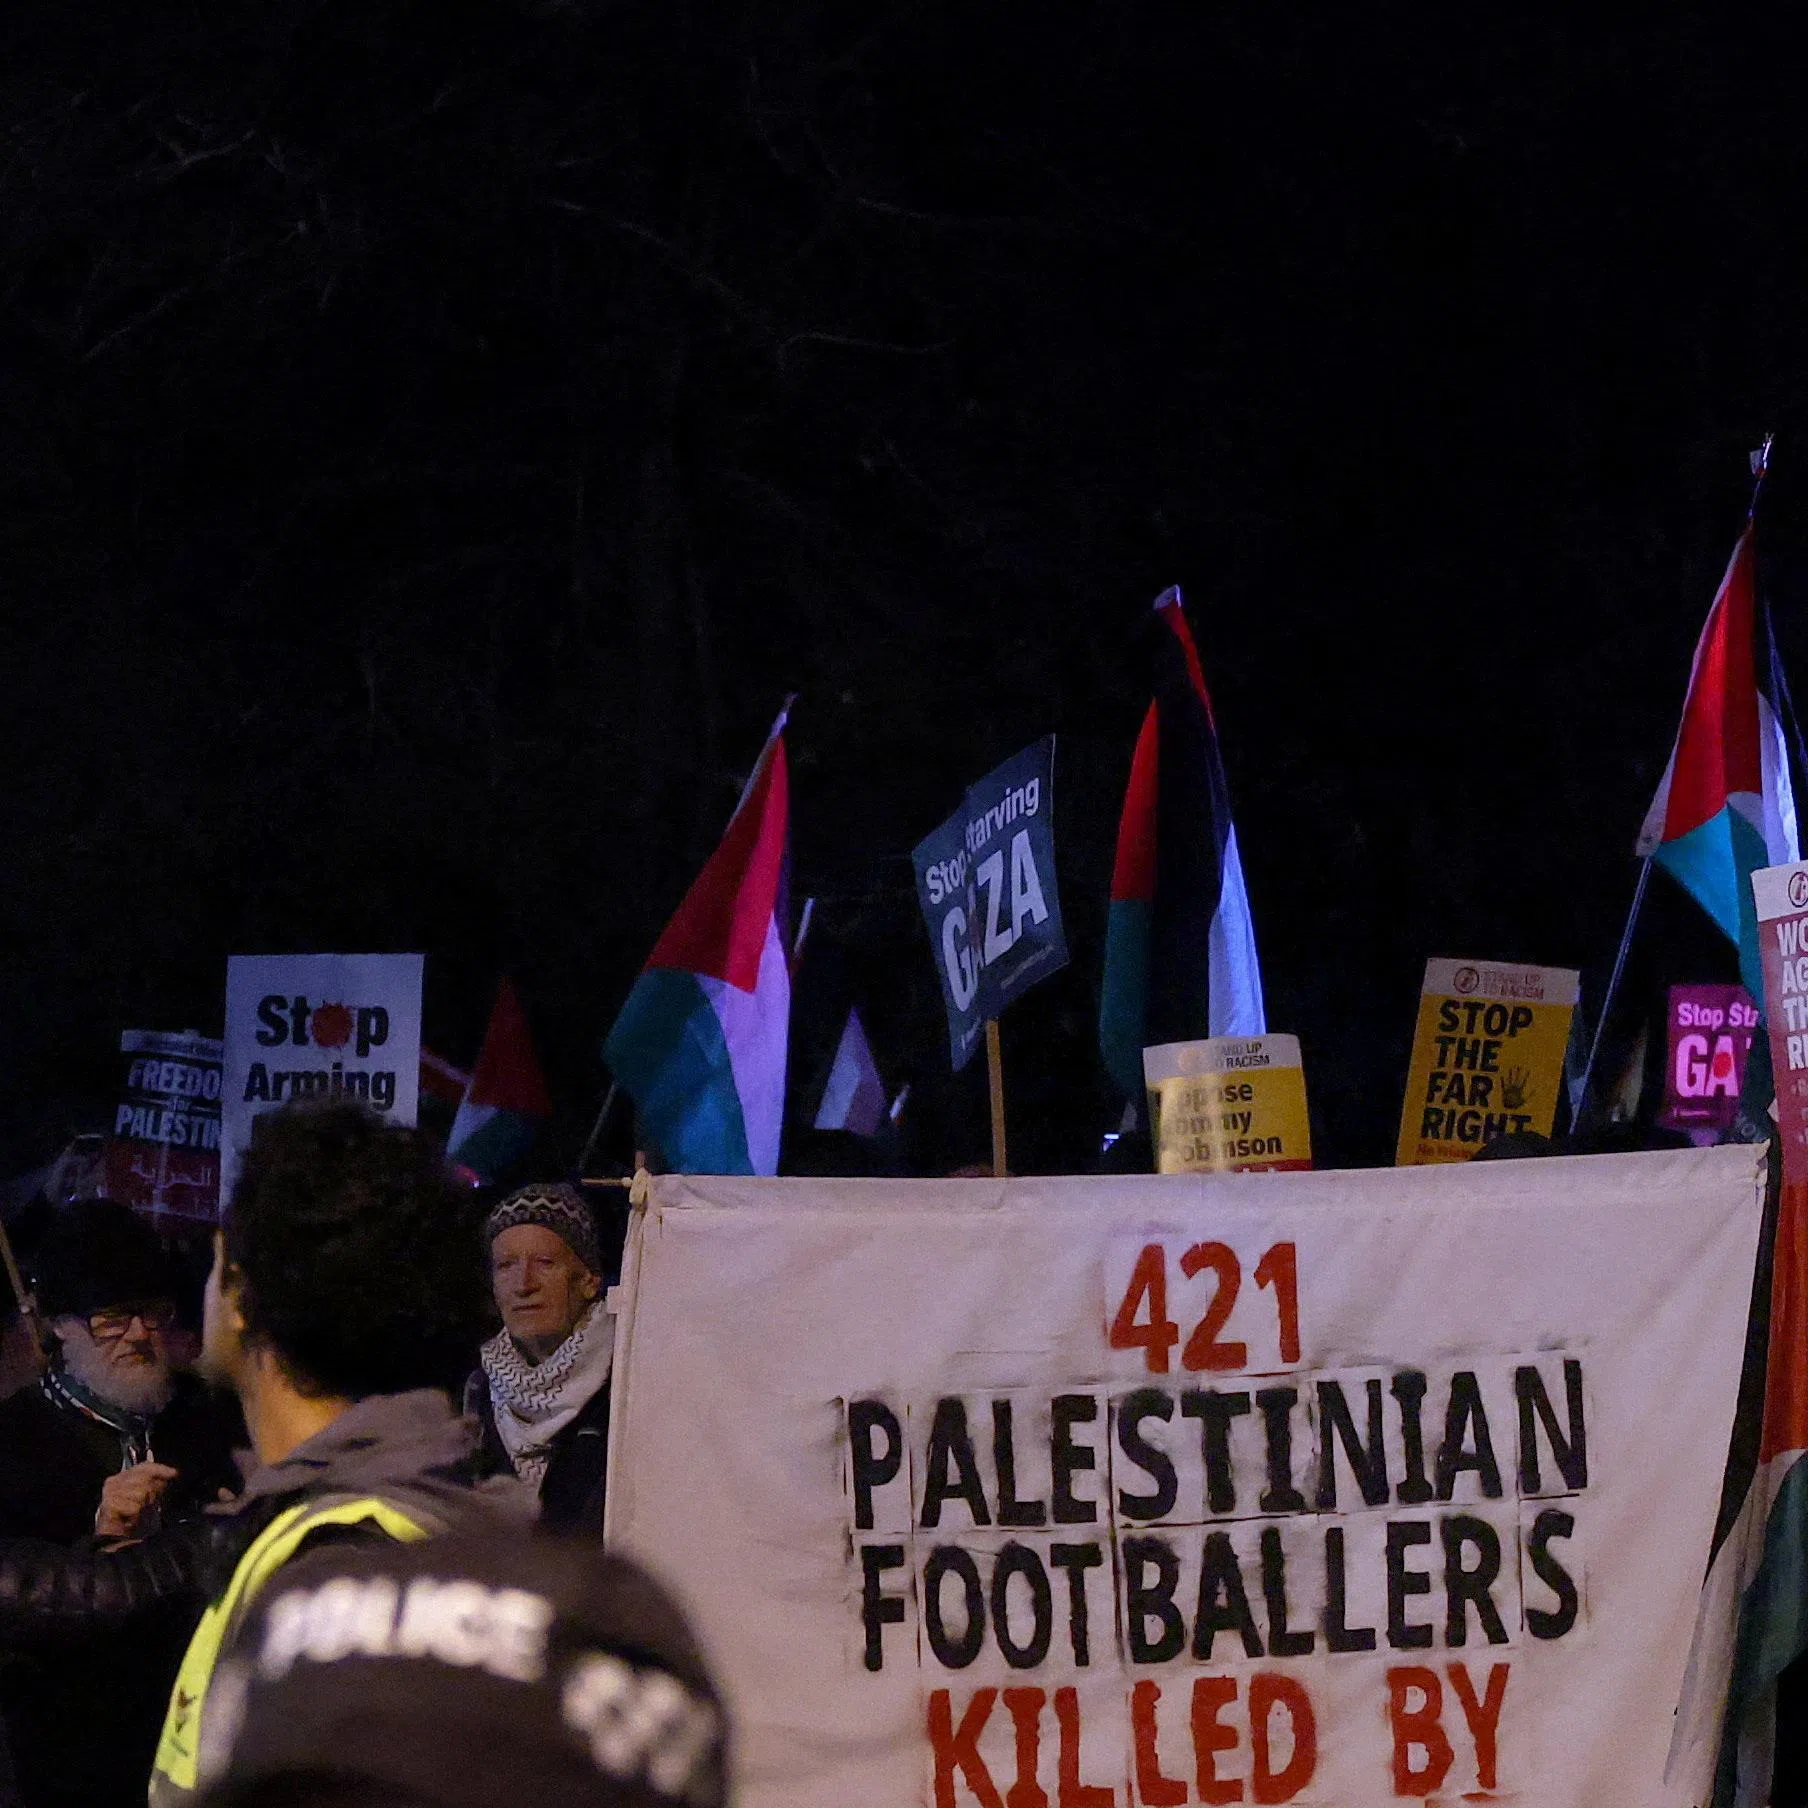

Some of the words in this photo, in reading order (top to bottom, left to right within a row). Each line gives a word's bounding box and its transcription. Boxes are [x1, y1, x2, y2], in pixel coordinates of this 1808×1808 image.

[926, 848, 968, 904] Stop
[965, 777, 1040, 862] tarving
[1439, 999, 1533, 1038] STOP
[1678, 1002, 1724, 1031] Stop
[1435, 1035, 1501, 1073] THE
[128, 1059, 221, 1100] FREEDO
[243, 1062, 396, 1111] Arming
[1427, 1072, 1493, 1107] FAR
[115, 1103, 221, 1151] PALESTIN
[1421, 1107, 1532, 1144] RIGHT
[1109, 1240, 1302, 1374] 421
[847, 1357, 1588, 1530] PALESTINIAN
[859, 1508, 1580, 1672] FOOTBALLERS
[256, 1573, 558, 1684] POLICE
[1390, 1662, 1510, 1798] BY
